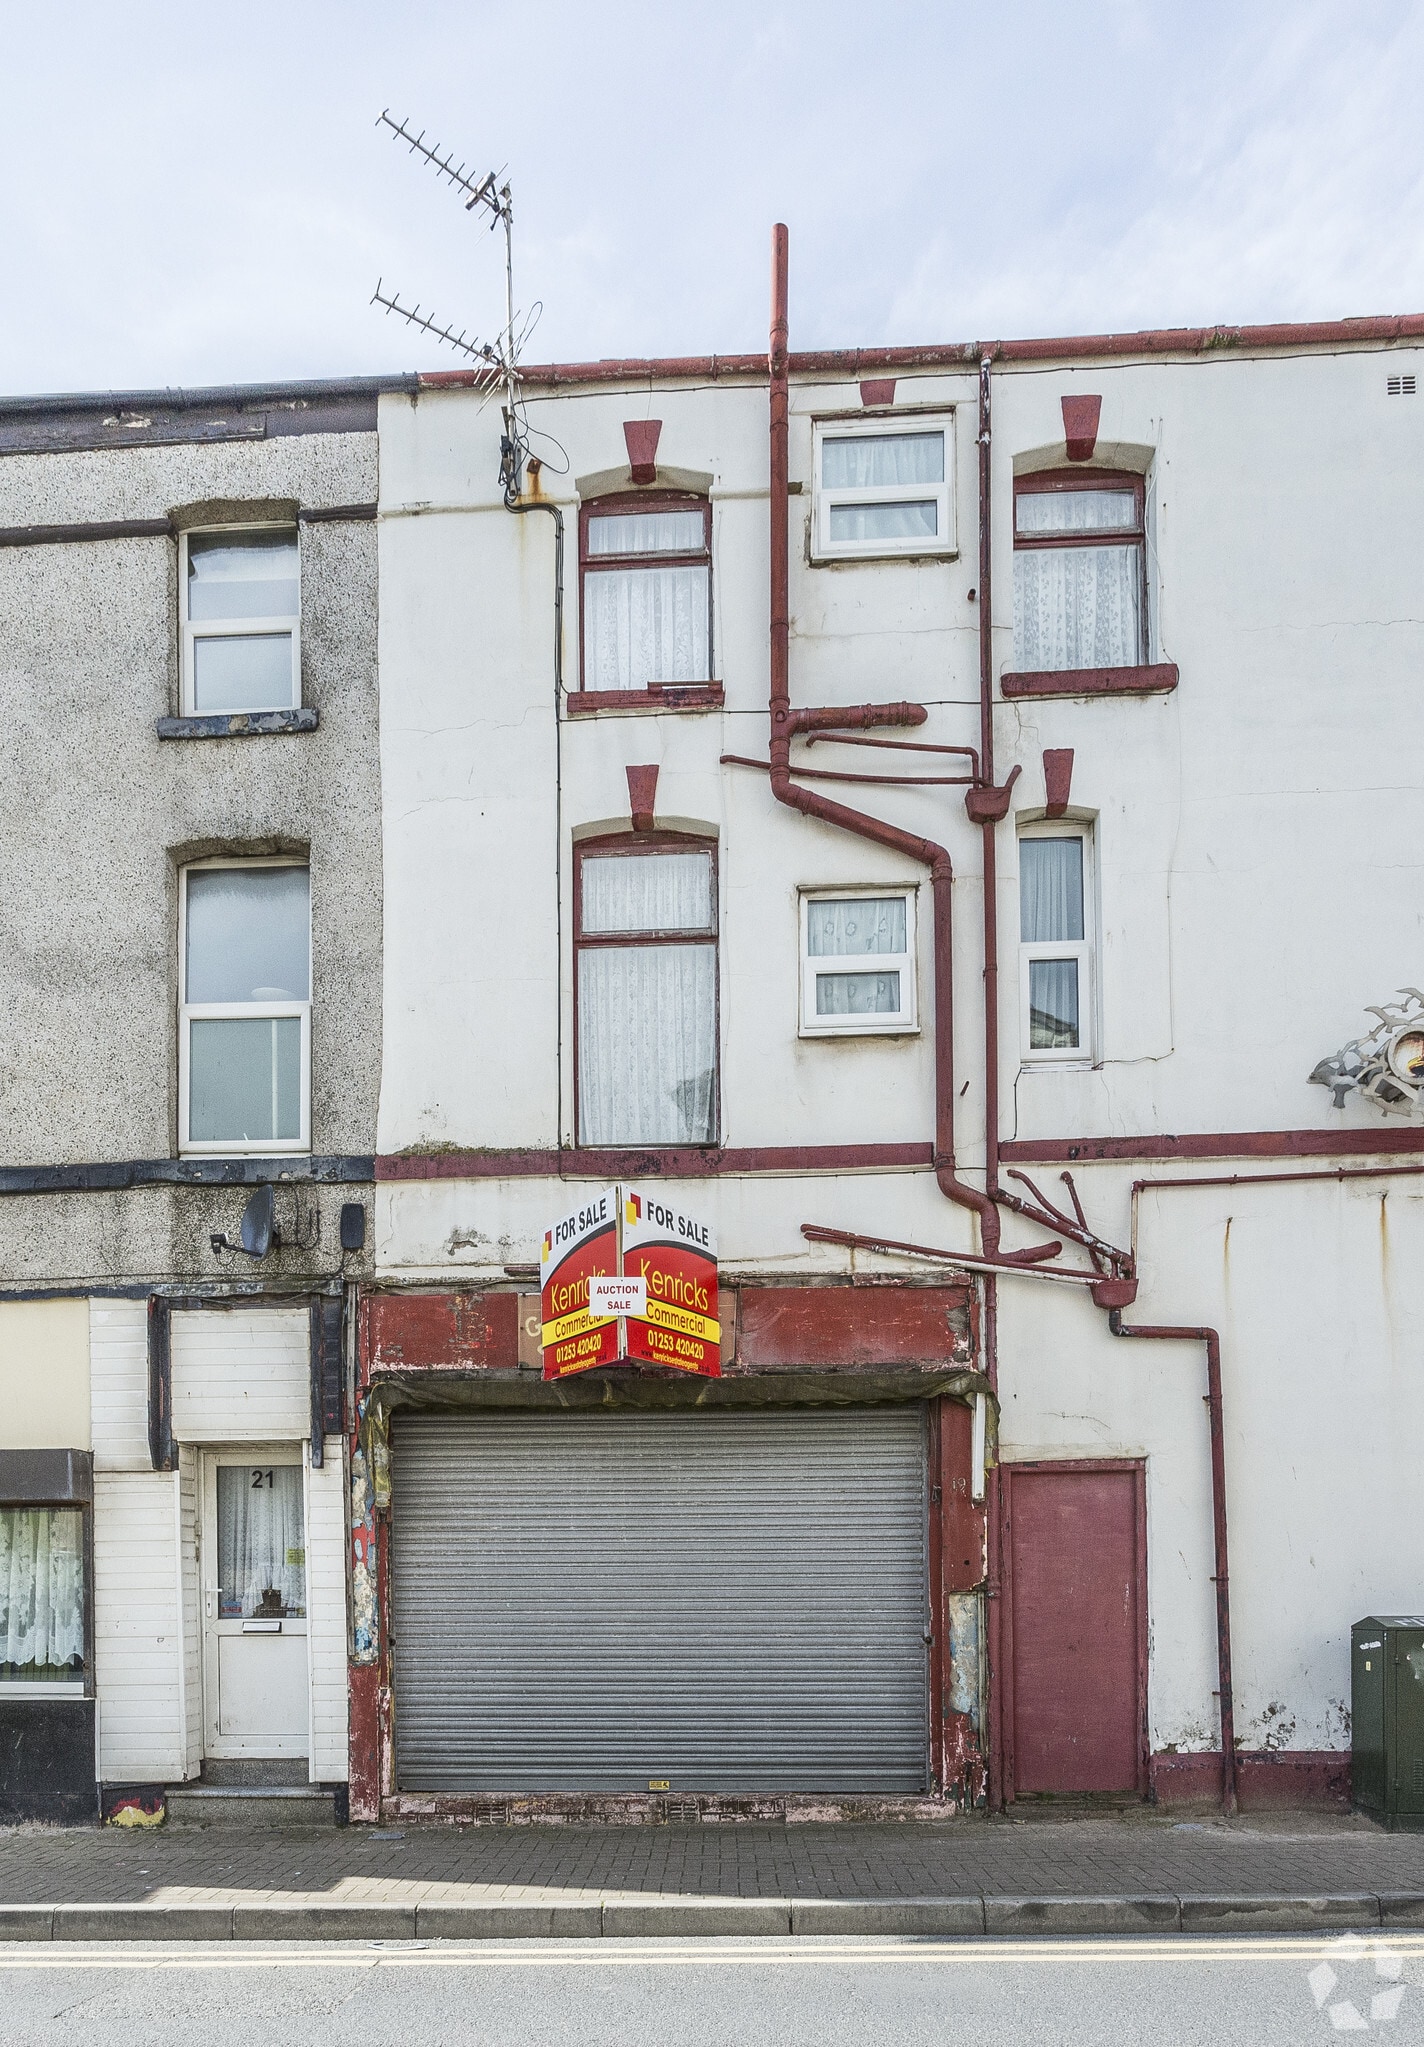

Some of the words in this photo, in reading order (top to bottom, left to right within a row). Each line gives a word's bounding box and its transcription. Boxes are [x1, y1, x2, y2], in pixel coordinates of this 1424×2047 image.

[555, 1220, 577, 1245] FOR
[578, 1198, 607, 1231] SALE
[647, 1201, 674, 1231] FOR
[678, 1215, 709, 1246] SALE
[597, 1286, 639, 1294] AUCTION
[640, 1259, 708, 1311] Kenricks
[607, 1301, 631, 1310] SALE
[646, 1302, 706, 1334] Commercial
[556, 1346, 576, 1363] 01253
[577, 1334, 601, 1356] 420420
[648, 1330, 674, 1351] 01253
[675, 1339, 704, 1360] 420420
[251, 1470, 274, 1488] 21
